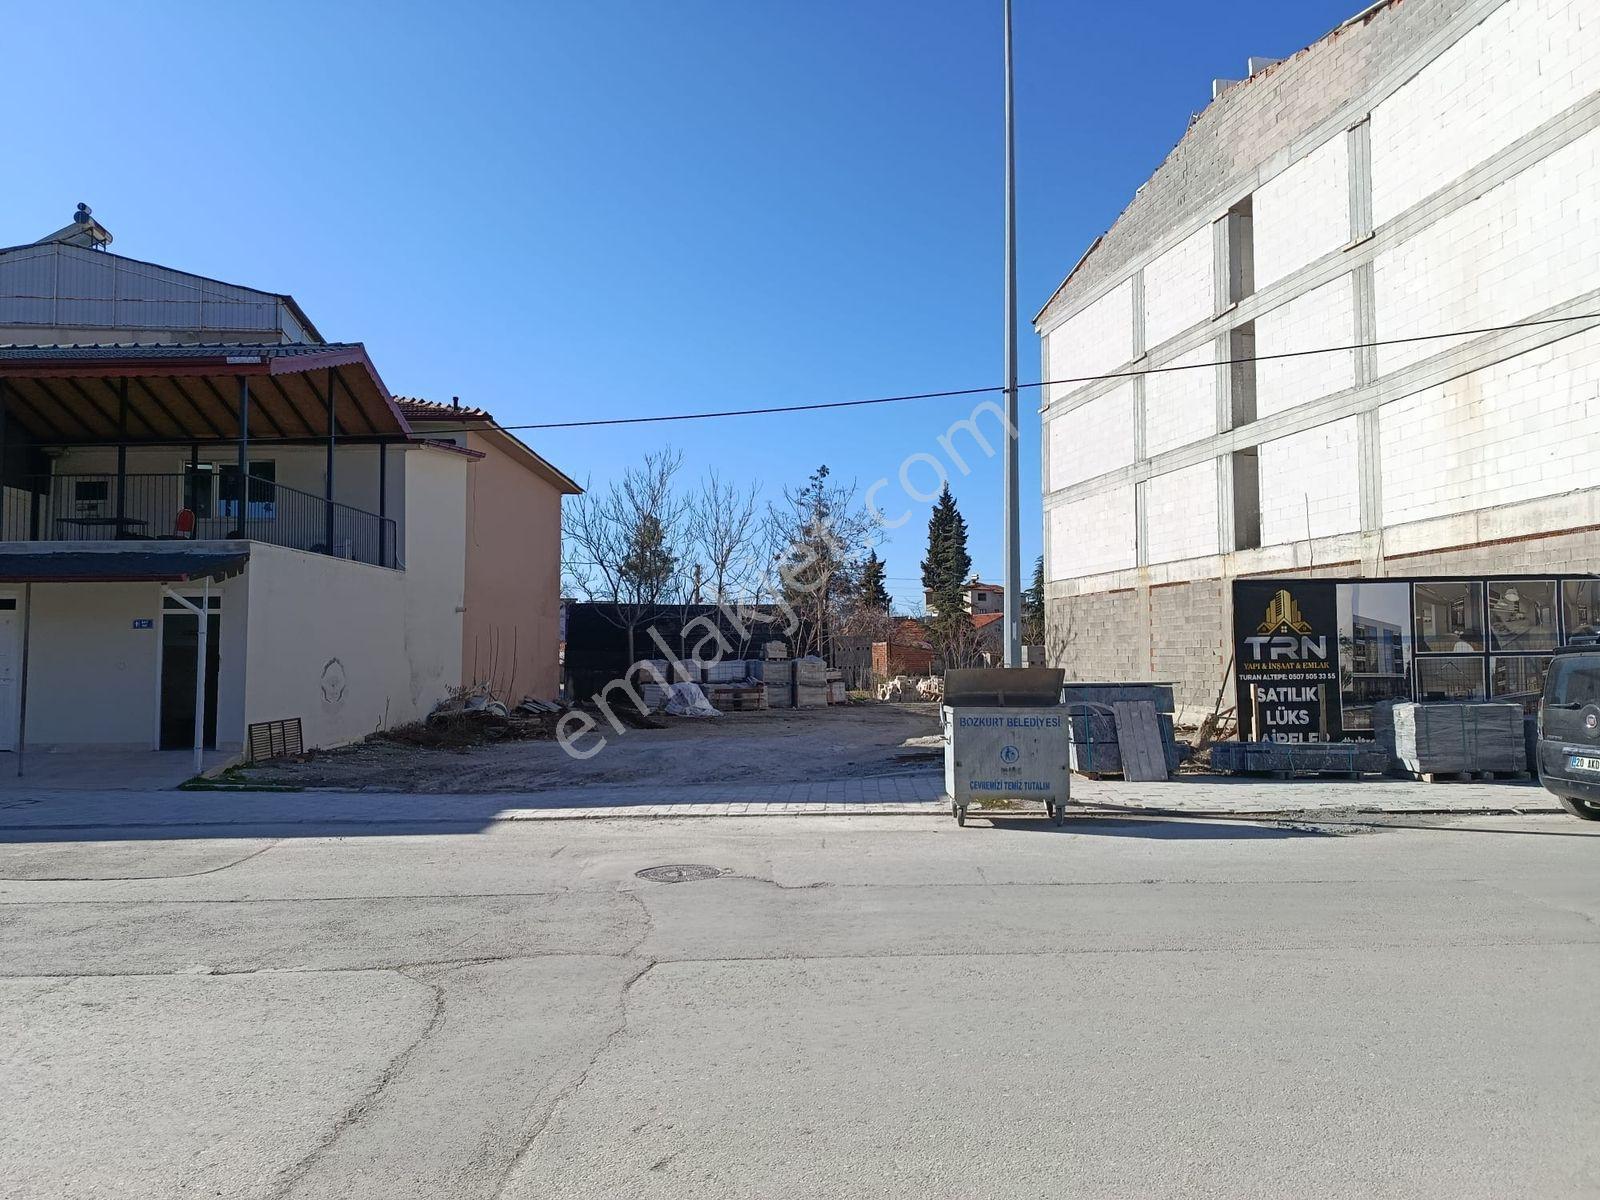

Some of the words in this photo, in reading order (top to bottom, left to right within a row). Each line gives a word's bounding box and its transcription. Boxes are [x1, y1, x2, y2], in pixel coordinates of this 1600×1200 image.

[1244, 635, 1327, 660] TRN
[1257, 686, 1318, 703] SATILIK
[960, 717, 1003, 728] BOZKURT
[1007, 715, 1061, 728] BELEDİYESİ
[1266, 706, 1309, 725] LÜKS
[1576, 757, 1585, 768] 20
